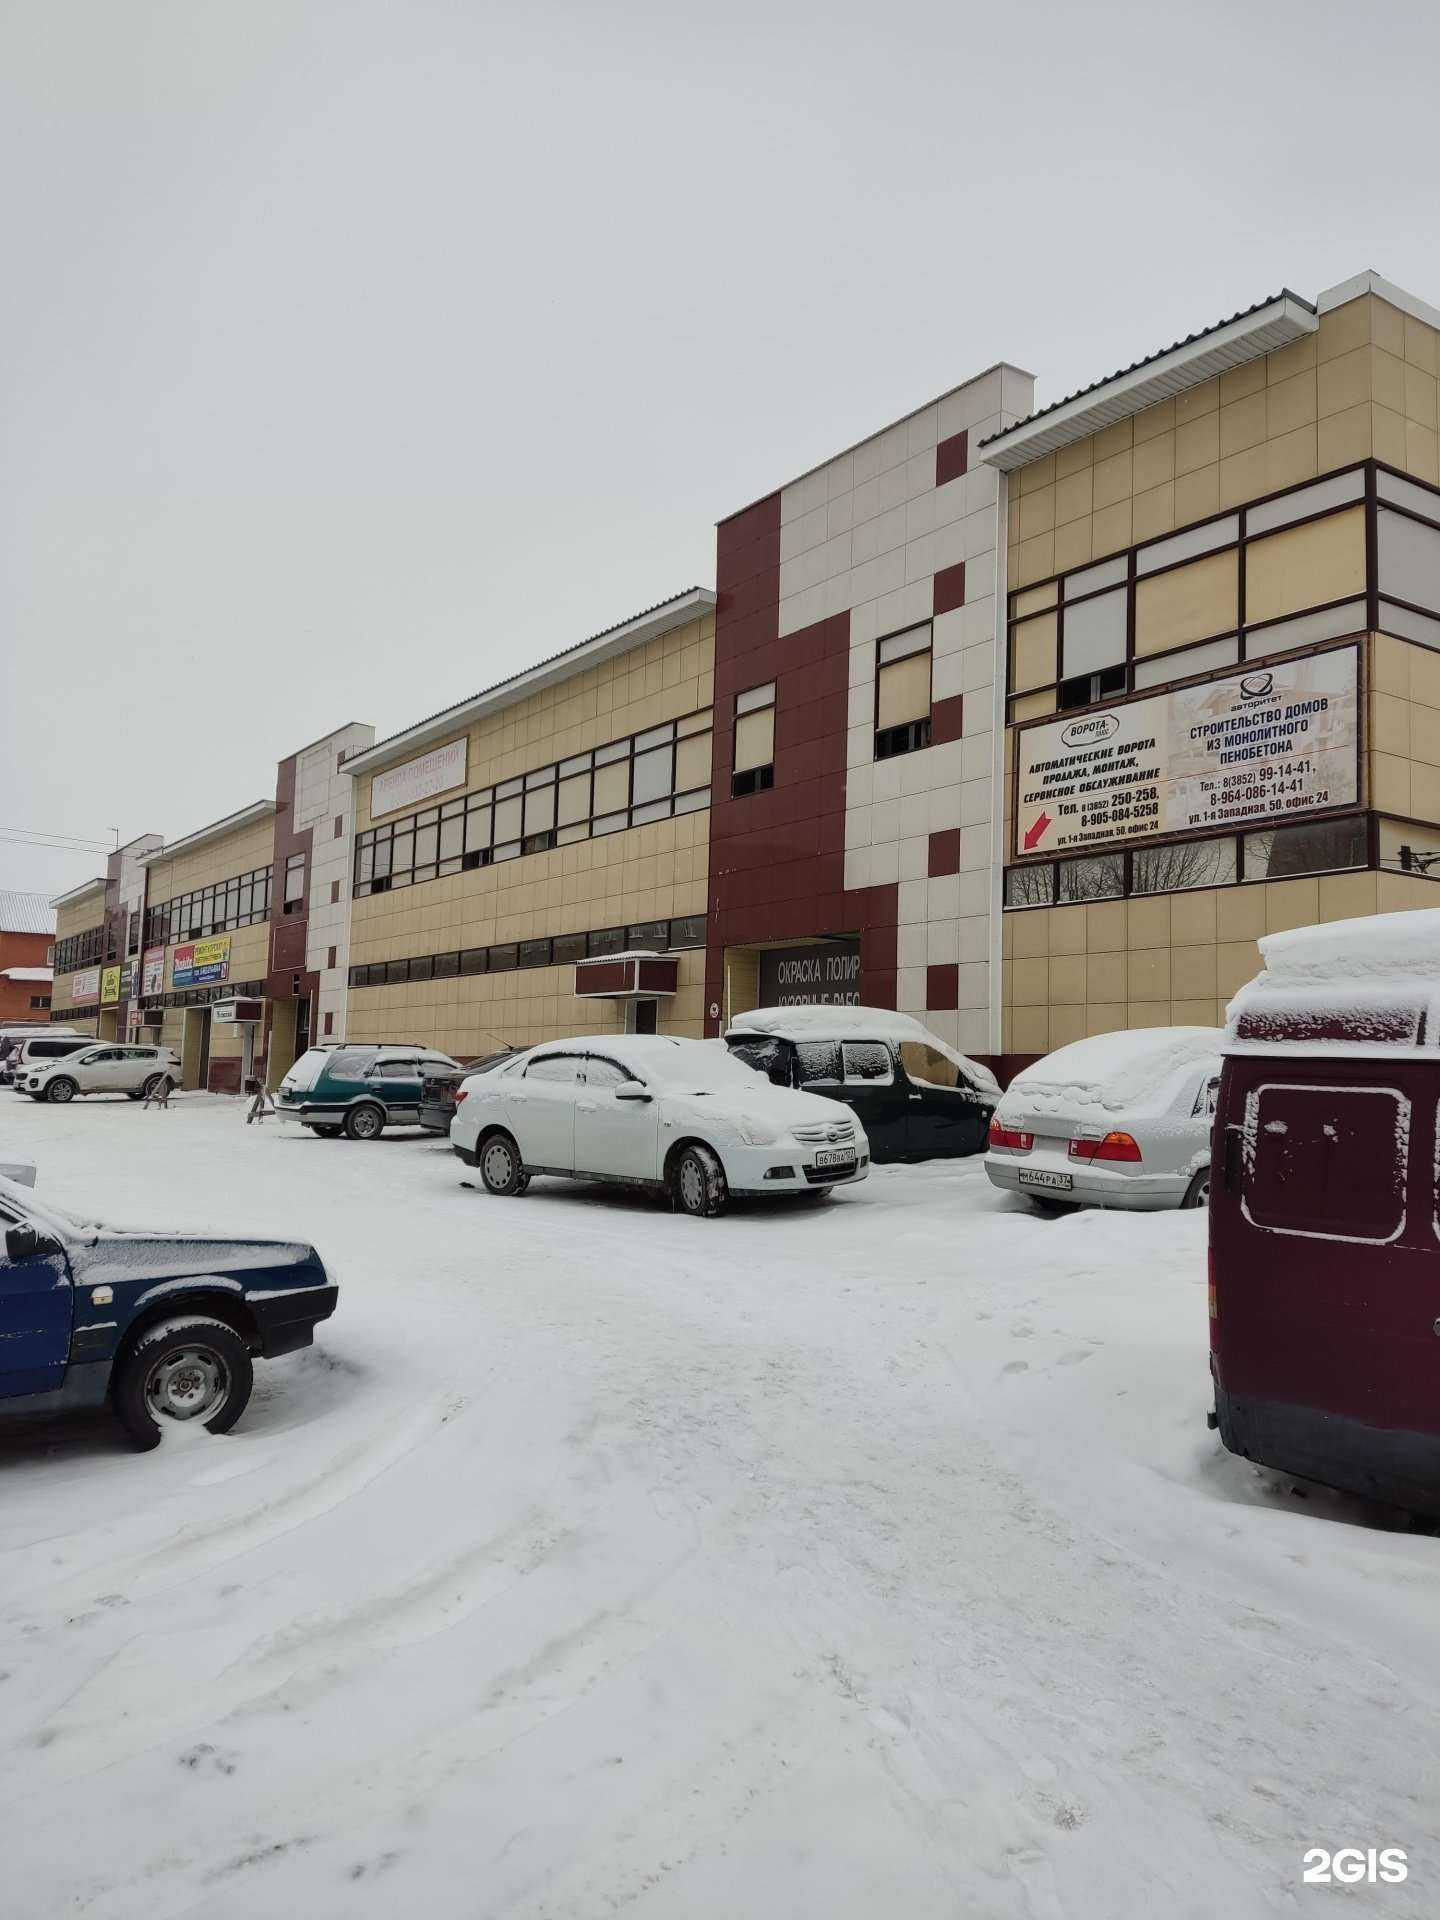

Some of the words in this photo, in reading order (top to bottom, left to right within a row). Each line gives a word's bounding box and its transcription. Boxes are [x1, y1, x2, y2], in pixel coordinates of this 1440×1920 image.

[1231, 695, 1282, 712] авторитет
[1190, 709, 1281, 739] СТРОИТЕЛЬСТВО
[1284, 698, 1329, 720] ДОМОВ
[1207, 738, 1221, 752] ИЗ
[1224, 719, 1309, 748] МОНОЛИТНОГО
[1029, 747, 1114, 775] АВТОМАТИЧЕСКИЕ
[1117, 738, 1156, 756] ВОРОТА
[1220, 739, 1293, 765] ПЕНОБЕТОНА
[1043, 767, 1090, 785] ПРОДАЖА,
[1092, 757, 1139, 775] МОНТАЖ,
[1223, 772, 1256, 789] 8(3852)
[1024, 785, 1075, 804] СЕРВИСНОЕ
[1079, 768, 1161, 793] ОБСЛУЖИВАНИЕ
[1210, 778, 1304, 806] 8-964-086-14-41
[1058, 804, 1079, 815] Тел.
[1112, 787, 1160, 807] 250-258,
[1081, 802, 1159, 827] 8-905-084-5258
[1189, 815, 1202, 825] ул.
[1204, 811, 1216, 822] 1-я
[1286, 794, 1314, 809] офис
[1316, 791, 1329, 803] 24
[1057, 836, 1068, 846] ул.
[1128, 823, 1149, 836] офис
[1150, 820, 1159, 831] 24
[778, 960, 821, 984] ОКРАСКА
